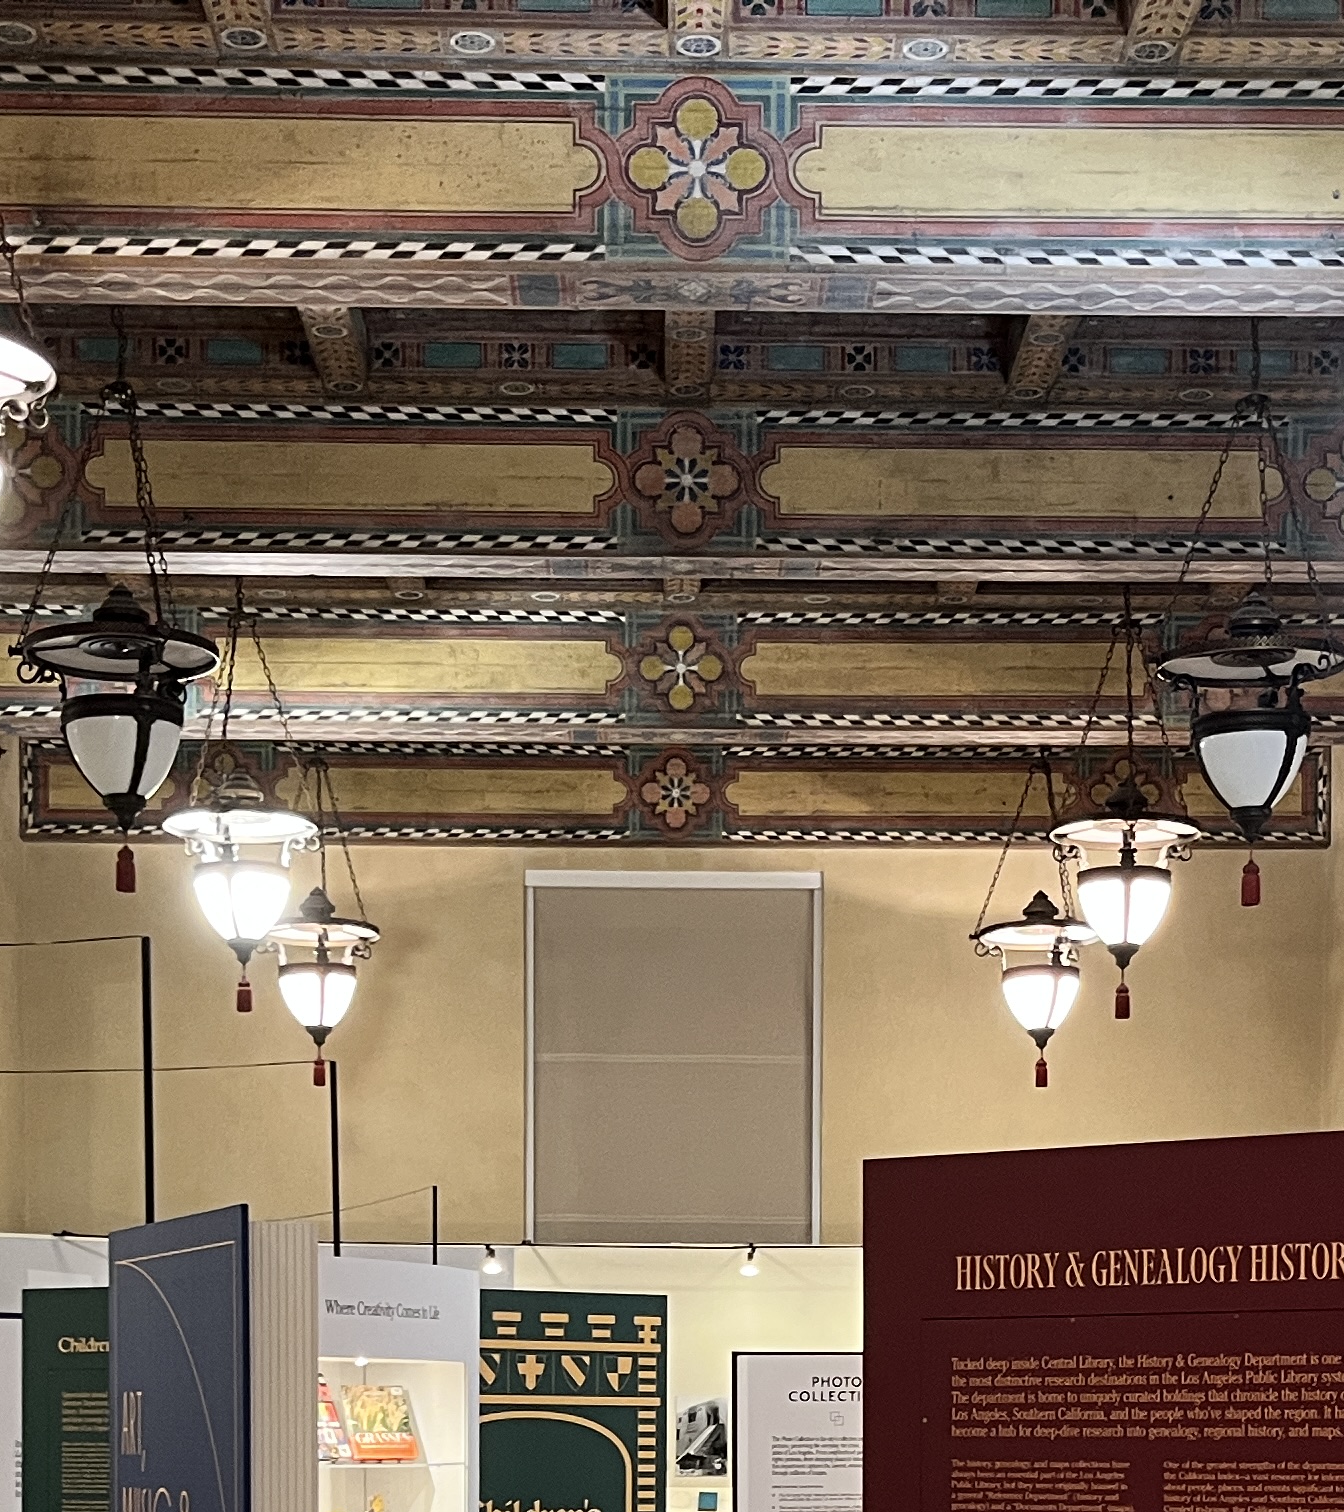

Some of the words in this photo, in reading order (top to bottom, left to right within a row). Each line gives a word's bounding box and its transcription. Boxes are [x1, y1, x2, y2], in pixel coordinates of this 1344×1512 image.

[955, 1252, 1060, 1291] HISTORY
[1065, 1251, 1086, 1288] &
[1091, 1244, 1244, 1287] GENEALOGY
[325, 1299, 356, 1315] Where
[357, 1301, 395, 1321] Creativity
[396, 1303, 421, 1319] Comes
[811, 1376, 862, 1388] PHOTO
[788, 1390, 862, 1402] COLLECTI
[121, 1391, 146, 1472] ART,
